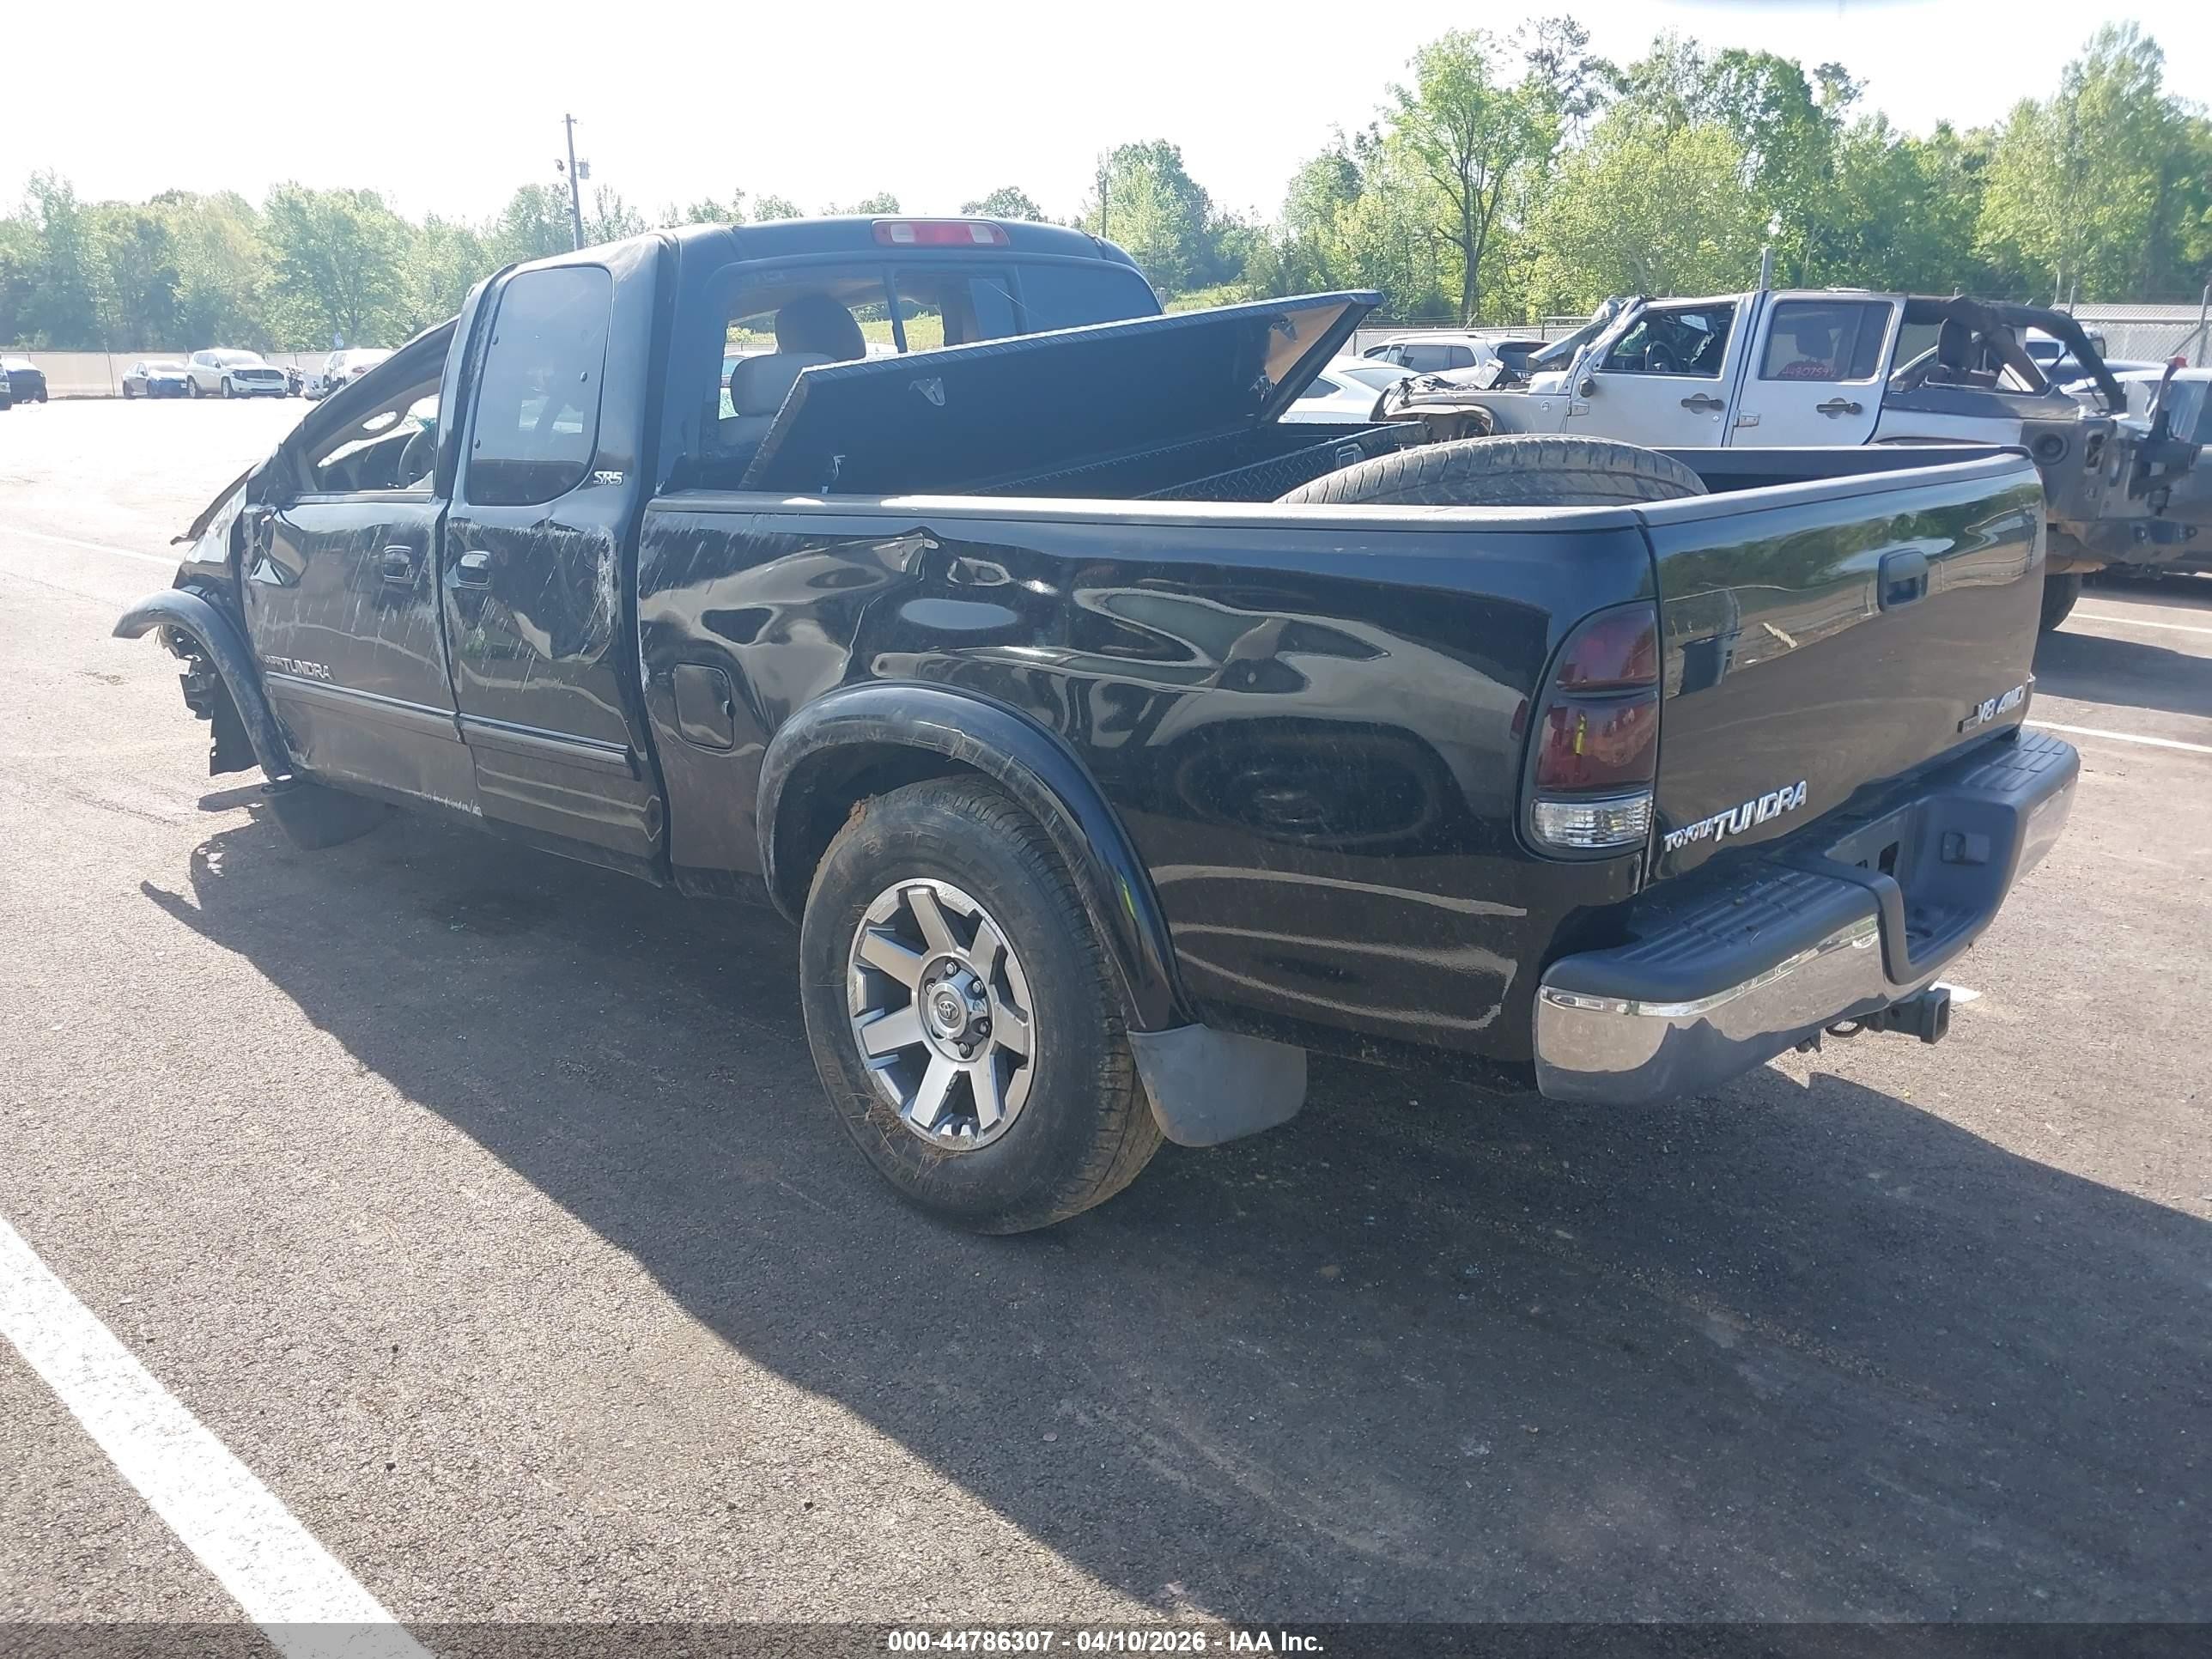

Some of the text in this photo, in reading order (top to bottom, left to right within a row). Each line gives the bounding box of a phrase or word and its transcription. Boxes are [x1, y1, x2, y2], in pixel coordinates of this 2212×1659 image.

[592, 471, 623, 485] SR5
[280, 658, 336, 680] TUNDRA
[1978, 698, 1996, 725] V8
[1664, 780, 1808, 853] TOYOTA TUNDRA
